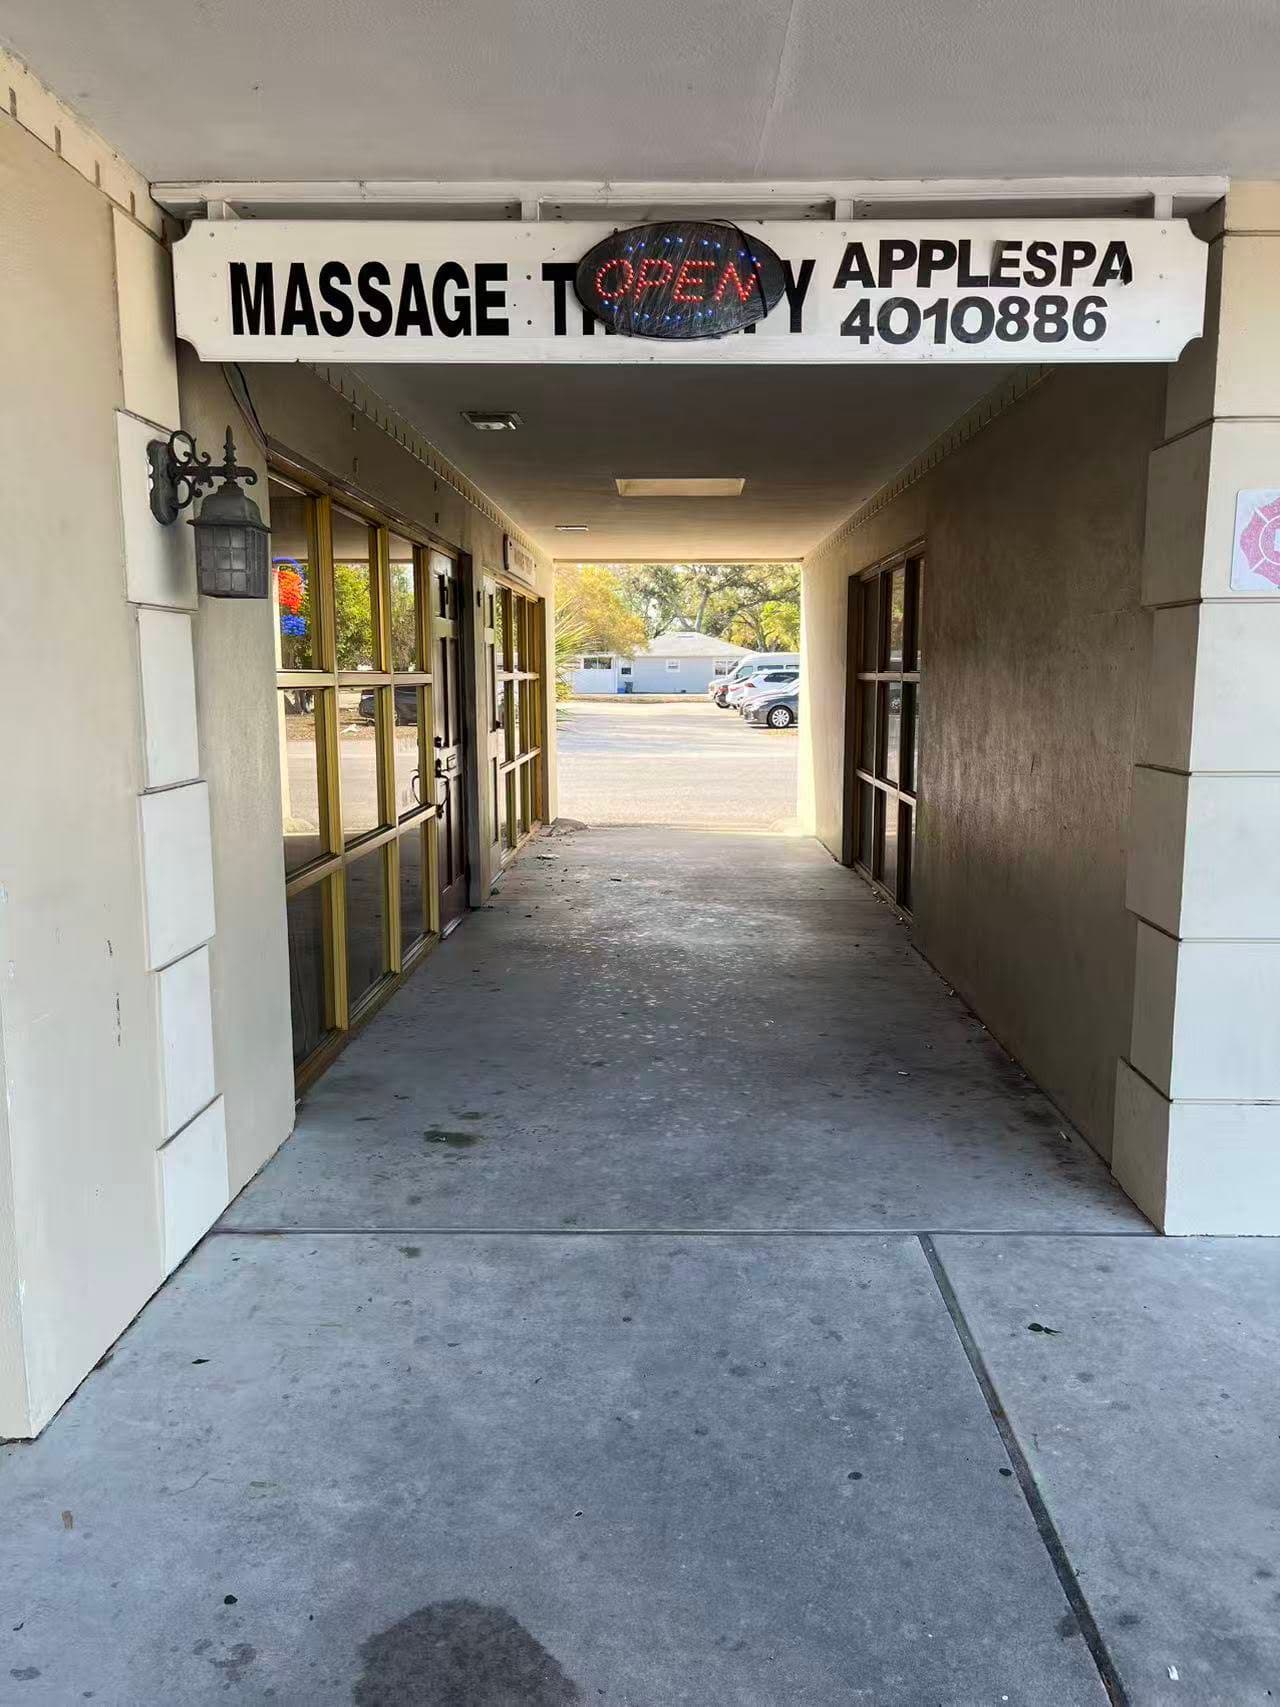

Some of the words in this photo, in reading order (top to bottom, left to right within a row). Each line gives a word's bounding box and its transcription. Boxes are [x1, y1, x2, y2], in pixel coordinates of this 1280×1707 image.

[229, 261, 510, 338] MASSAGE
[594, 258, 762, 304] OPEN
[840, 295, 1108, 345] 4010886
